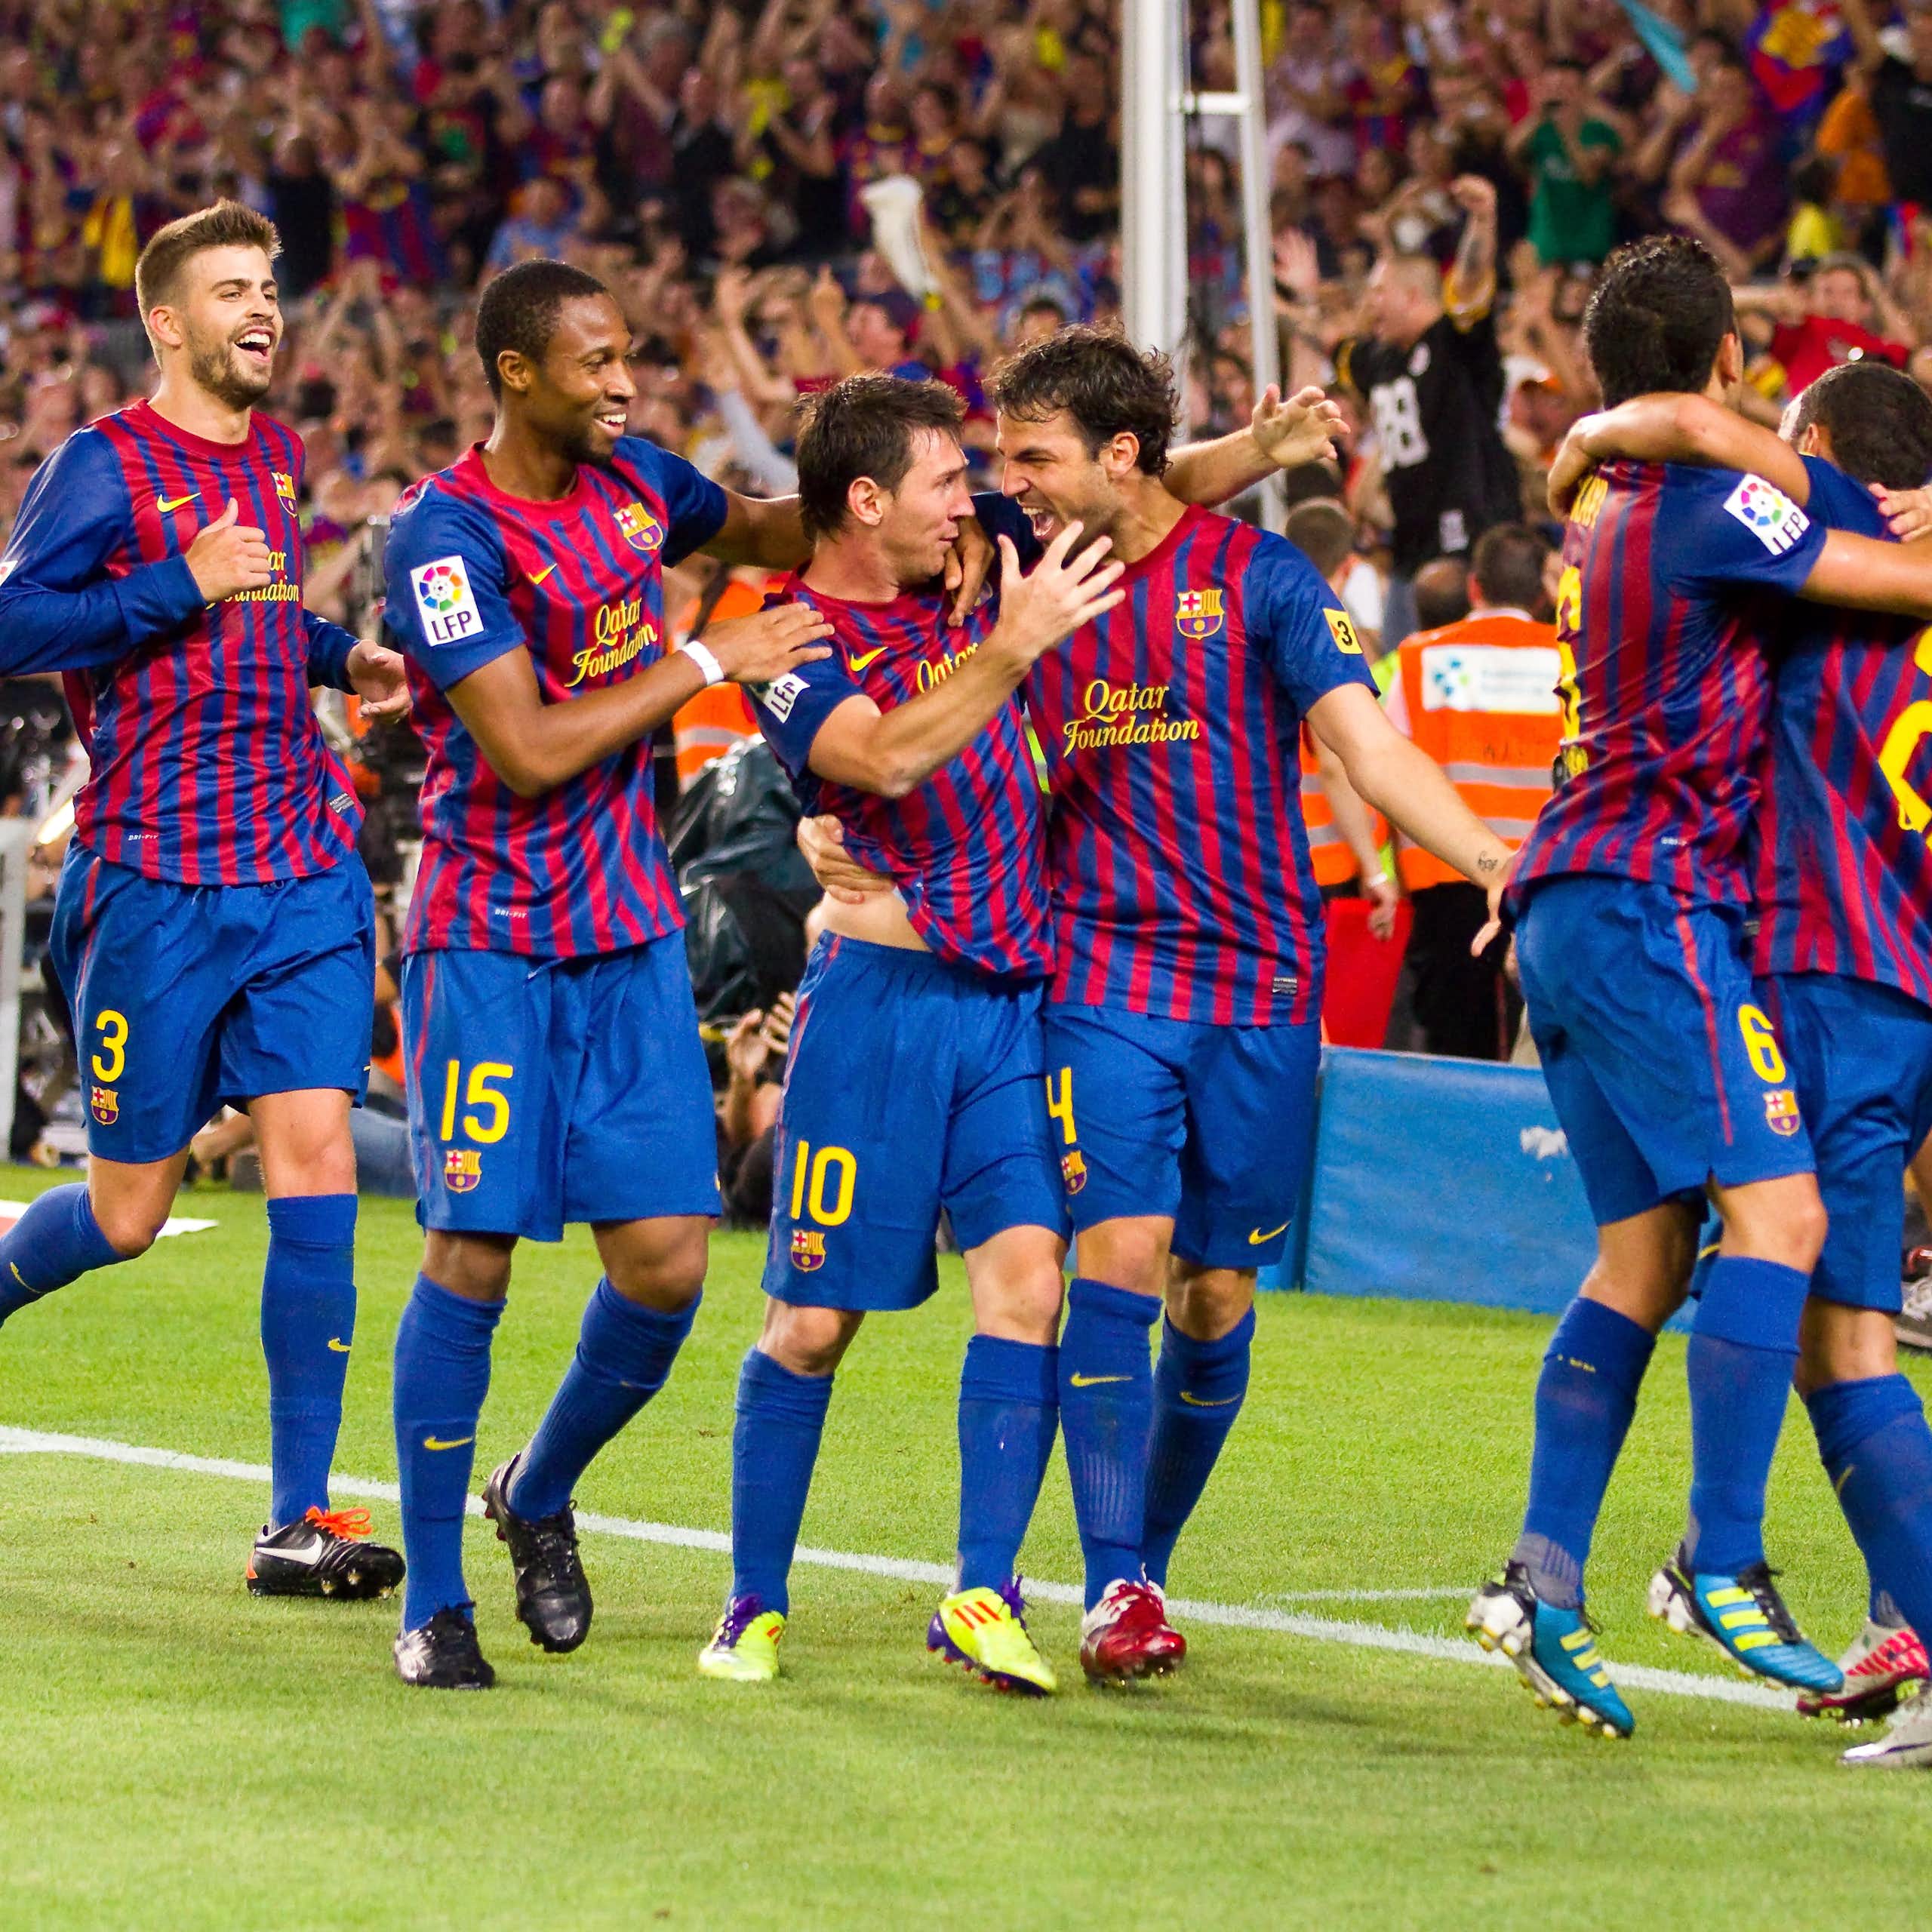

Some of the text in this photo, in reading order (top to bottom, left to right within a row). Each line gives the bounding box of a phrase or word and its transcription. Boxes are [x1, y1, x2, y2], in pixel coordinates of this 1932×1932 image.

[431, 610, 472, 641] LFP
[595, 597, 642, 647] Qatar
[1337, 620, 1352, 647] 3
[771, 681, 795, 715] LFP
[1084, 679, 1170, 723] Qatar
[1063, 712, 1200, 758] Foundation
[91, 1009, 129, 1083] 3
[1738, 1004, 1786, 1084] 6
[440, 1059, 514, 1144] 15
[1044, 1066, 1077, 1145] 4
[790, 1140, 857, 1227] 10
